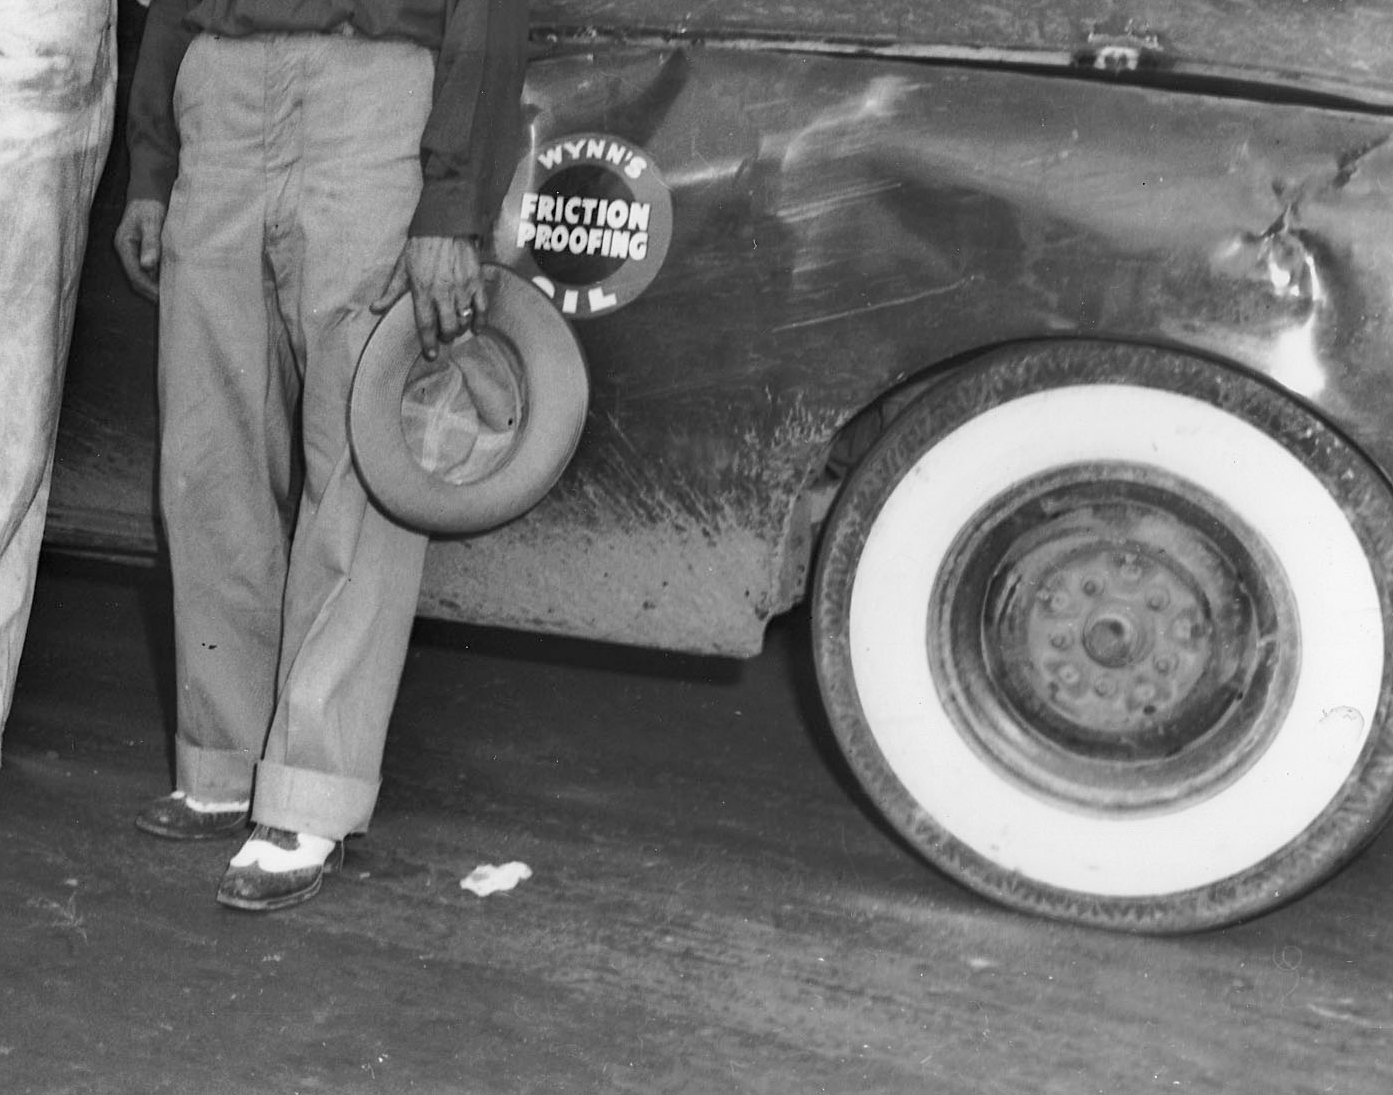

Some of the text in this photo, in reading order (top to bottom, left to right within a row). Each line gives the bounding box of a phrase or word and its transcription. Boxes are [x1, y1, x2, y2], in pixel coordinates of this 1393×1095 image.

[538, 137, 648, 180] WYNN'S
[519, 192, 651, 232] FRICTION
[516, 220, 649, 261] PROOFING
